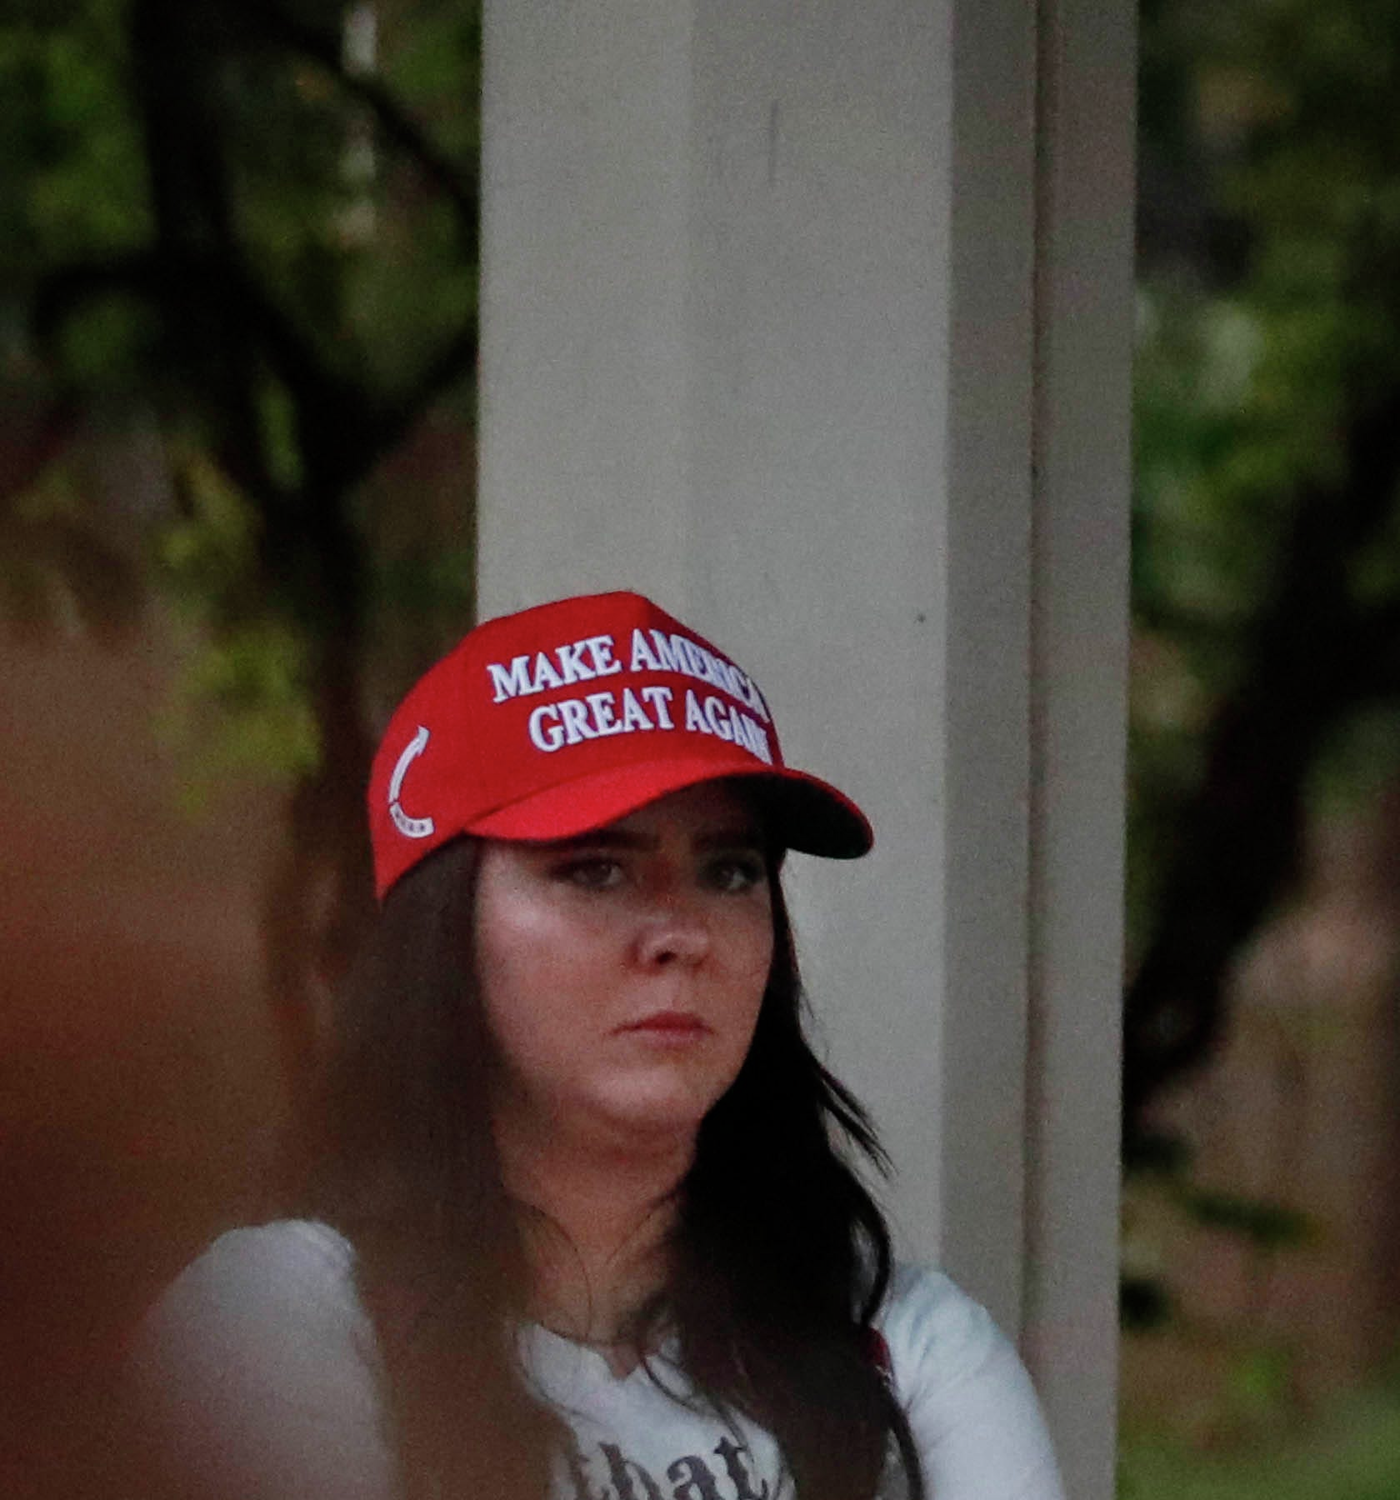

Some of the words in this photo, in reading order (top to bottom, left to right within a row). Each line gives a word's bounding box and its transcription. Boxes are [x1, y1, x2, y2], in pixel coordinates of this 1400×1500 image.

[486, 634, 622, 703] MAKE
[528, 686, 675, 752] GREAT
[685, 688, 774, 766] AGAIN
